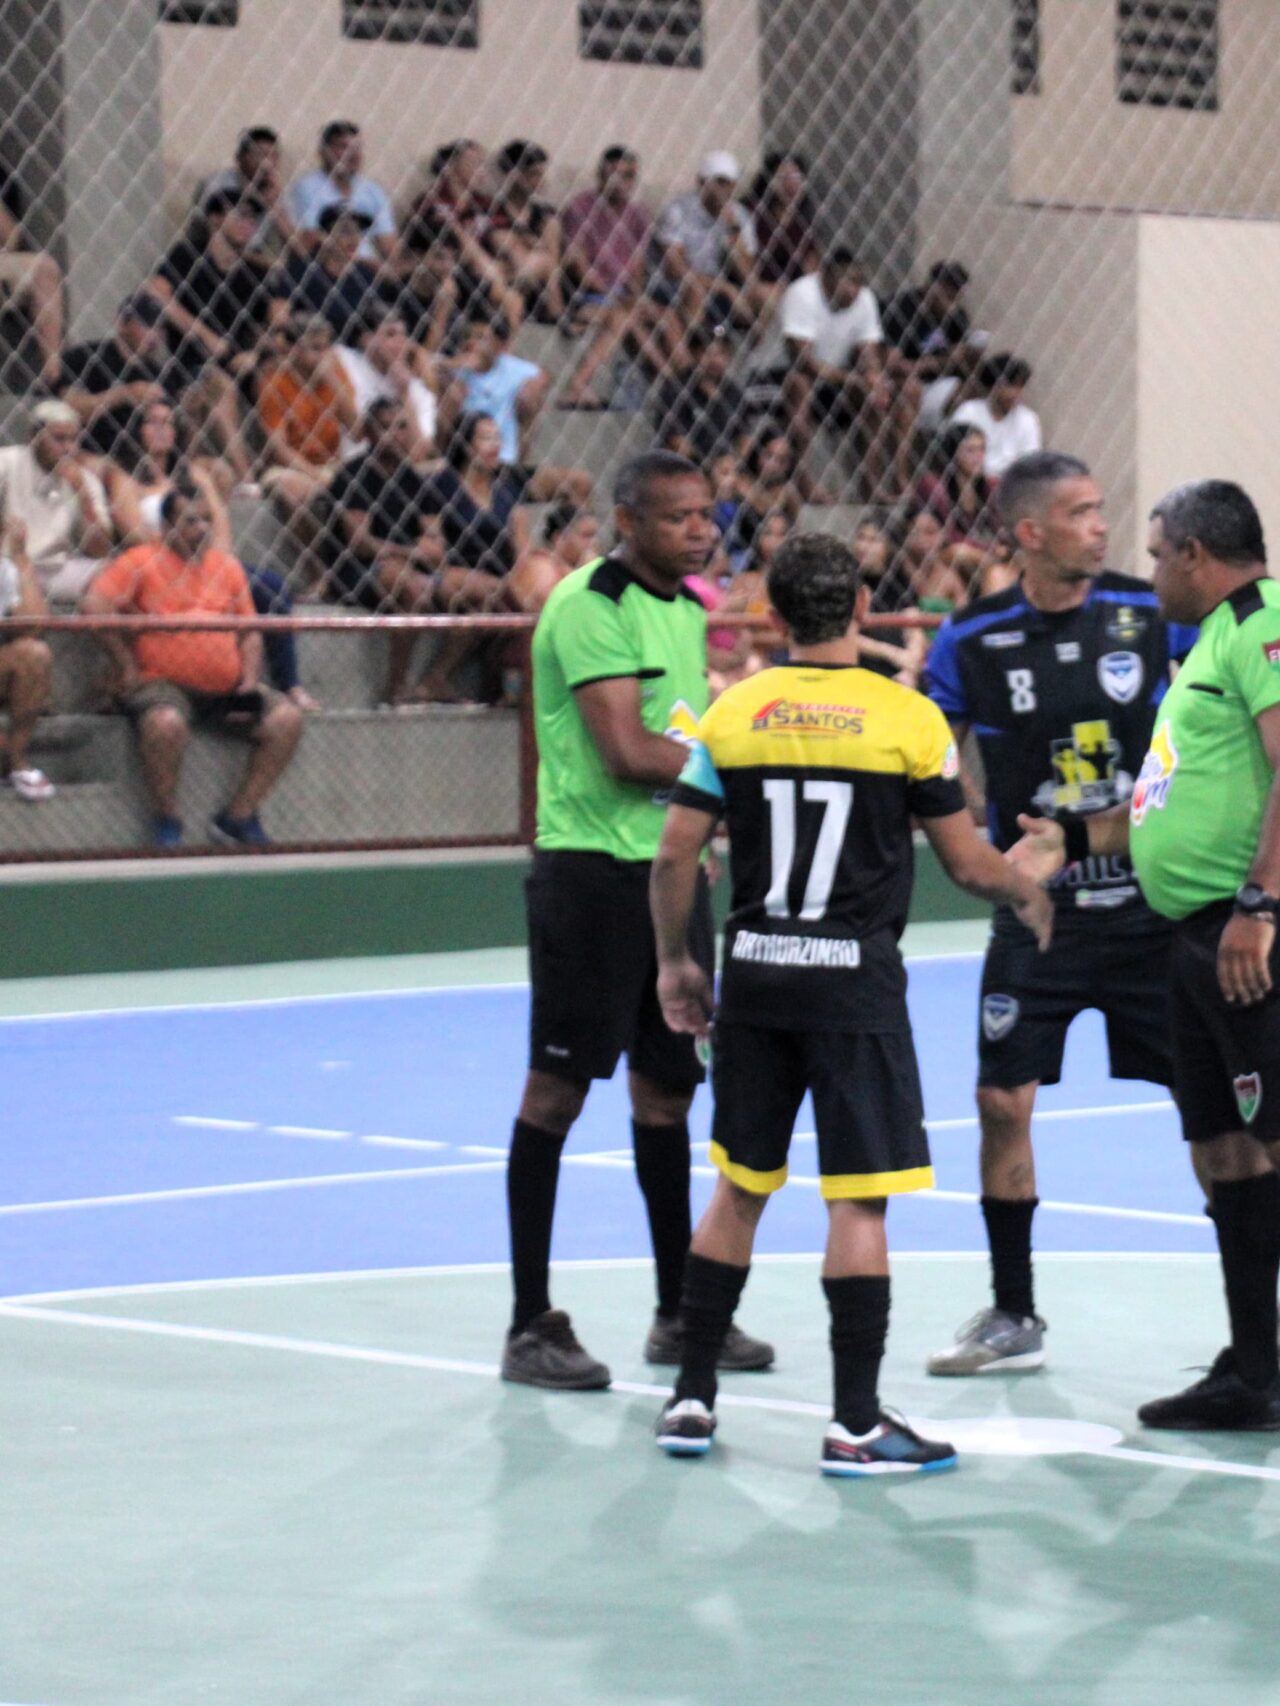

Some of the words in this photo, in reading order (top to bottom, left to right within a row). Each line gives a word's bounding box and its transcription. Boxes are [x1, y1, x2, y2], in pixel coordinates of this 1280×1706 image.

[1006, 669, 1037, 713] 8
[774, 708, 863, 734] SANTOS
[762, 779, 853, 920] 17
